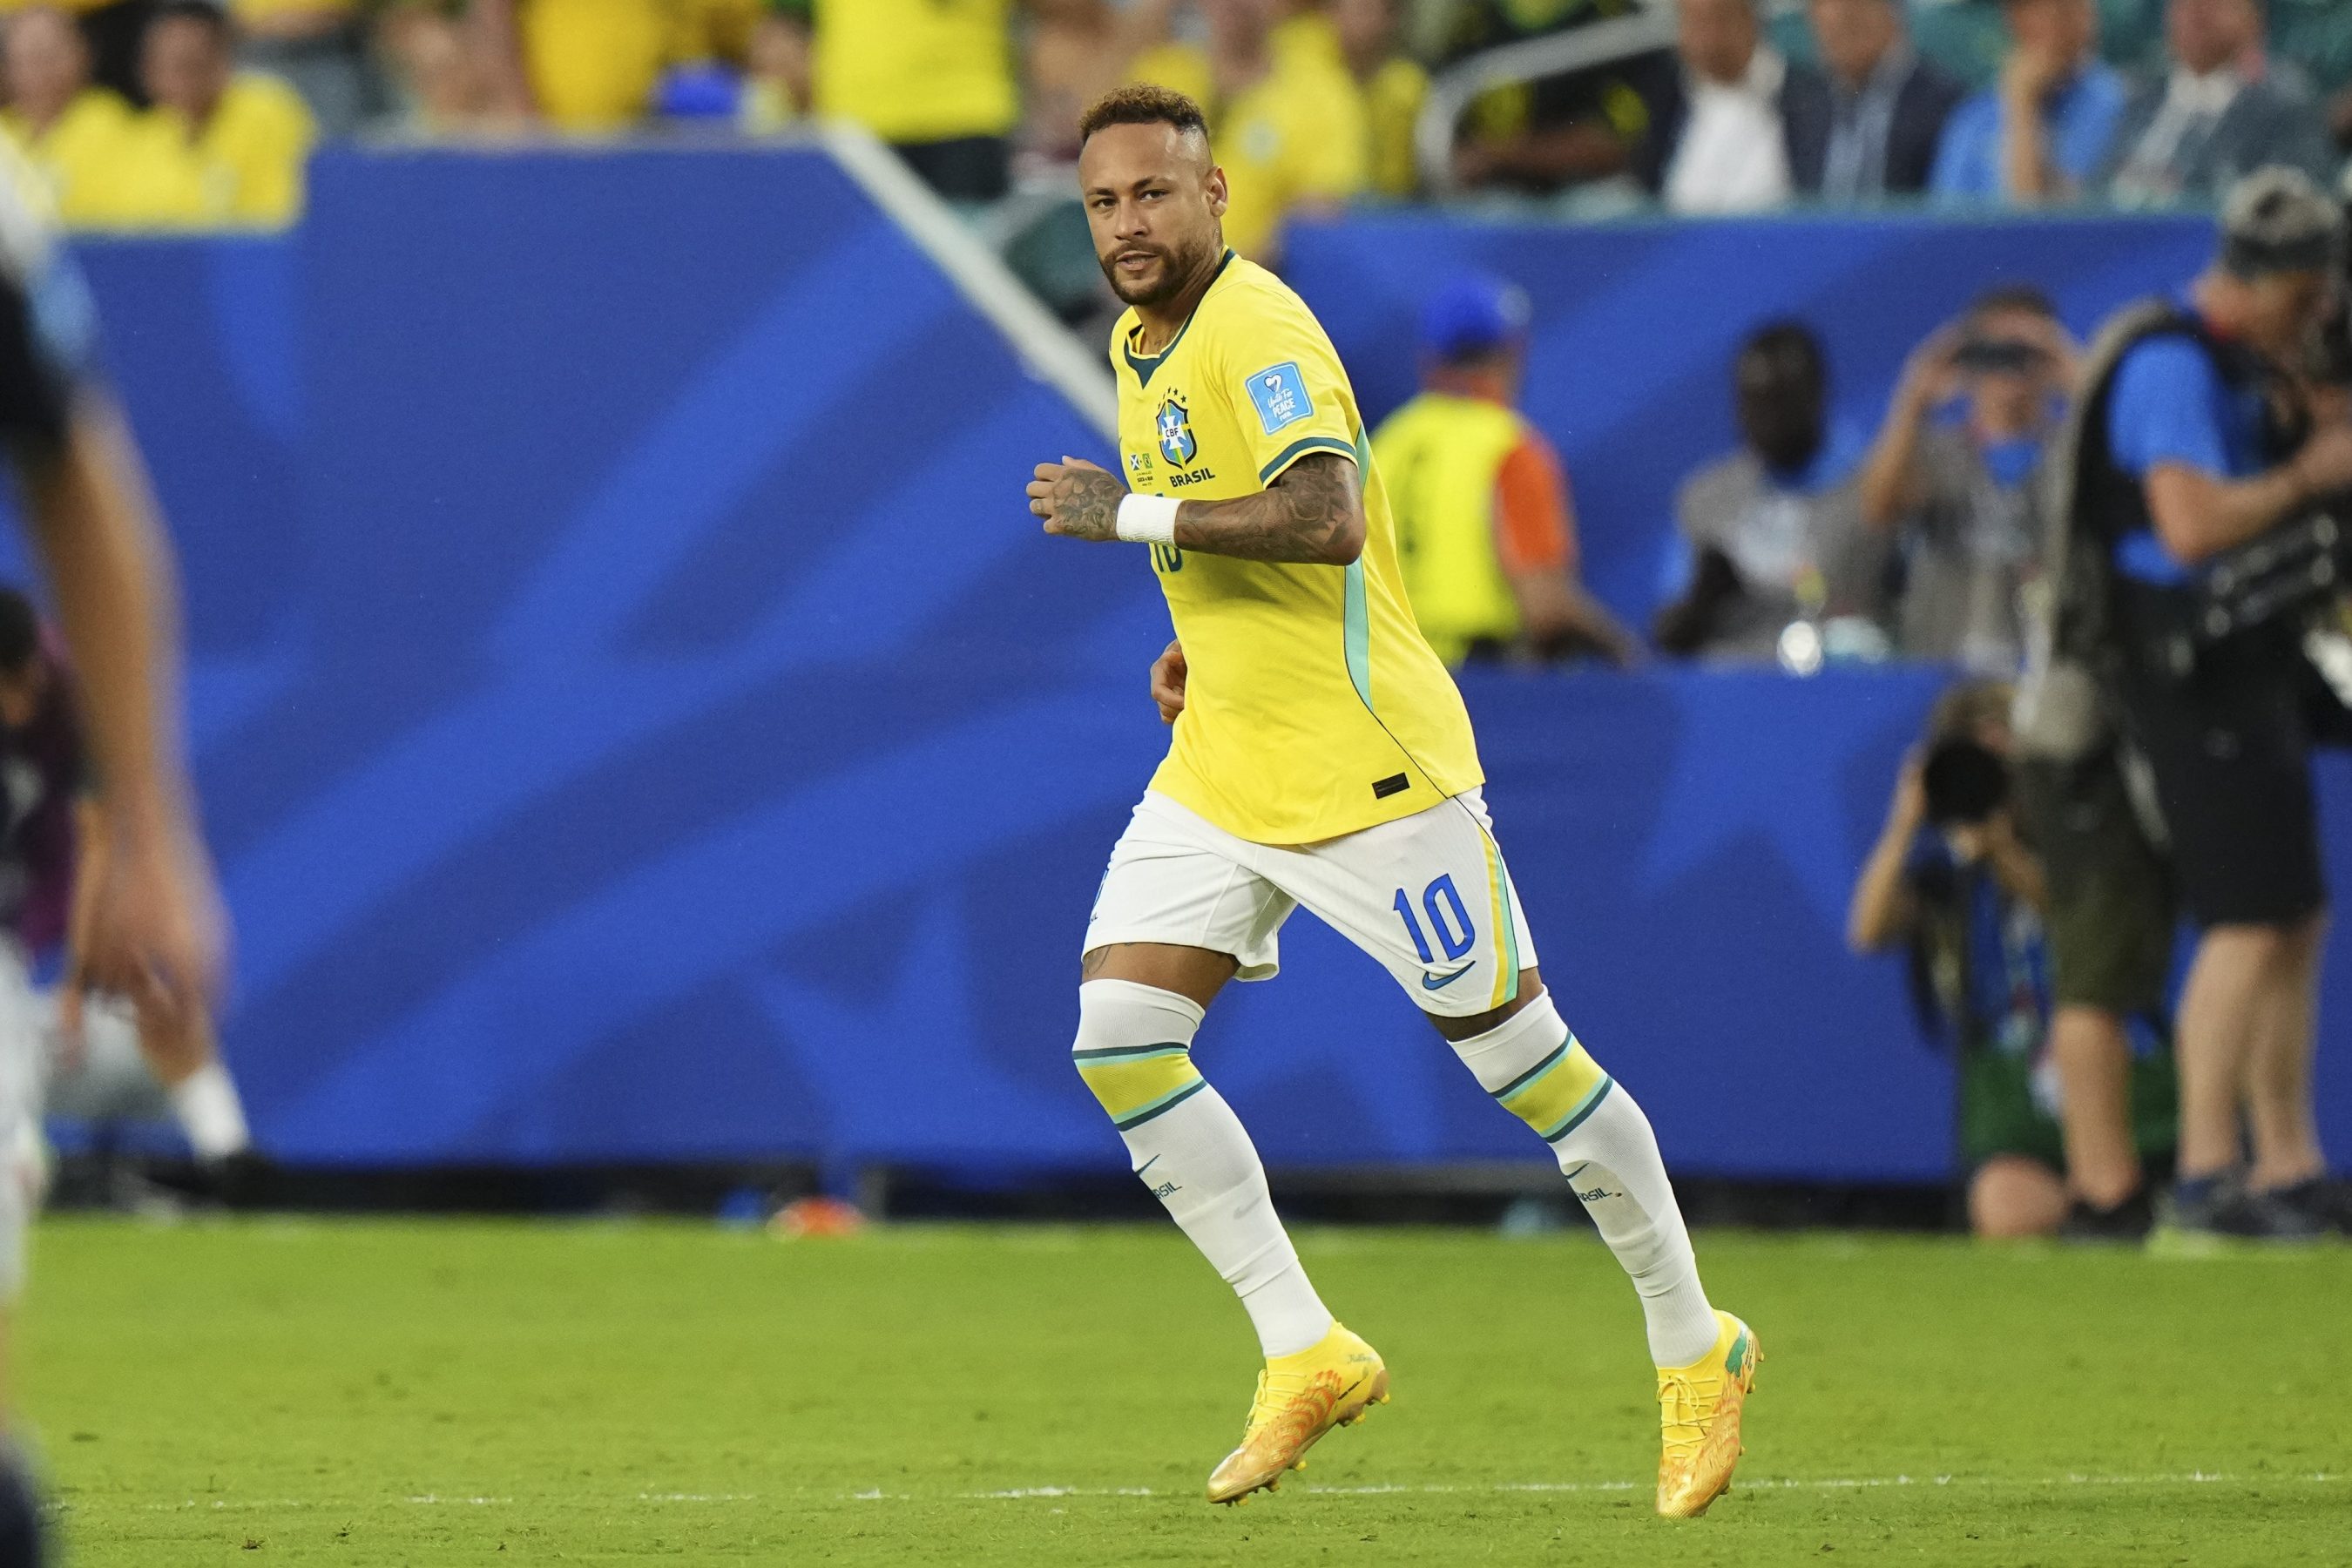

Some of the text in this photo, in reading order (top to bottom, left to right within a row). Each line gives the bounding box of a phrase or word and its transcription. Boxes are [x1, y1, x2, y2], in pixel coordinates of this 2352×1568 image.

[1272, 397, 1296, 418] PEACE
[1165, 427, 1179, 438] CBF
[1169, 467, 1216, 488] BRASIL
[1393, 872, 1476, 964] 10
[1151, 1181, 1183, 1200] ASIL
[1577, 1187, 1613, 1202] ASIL
